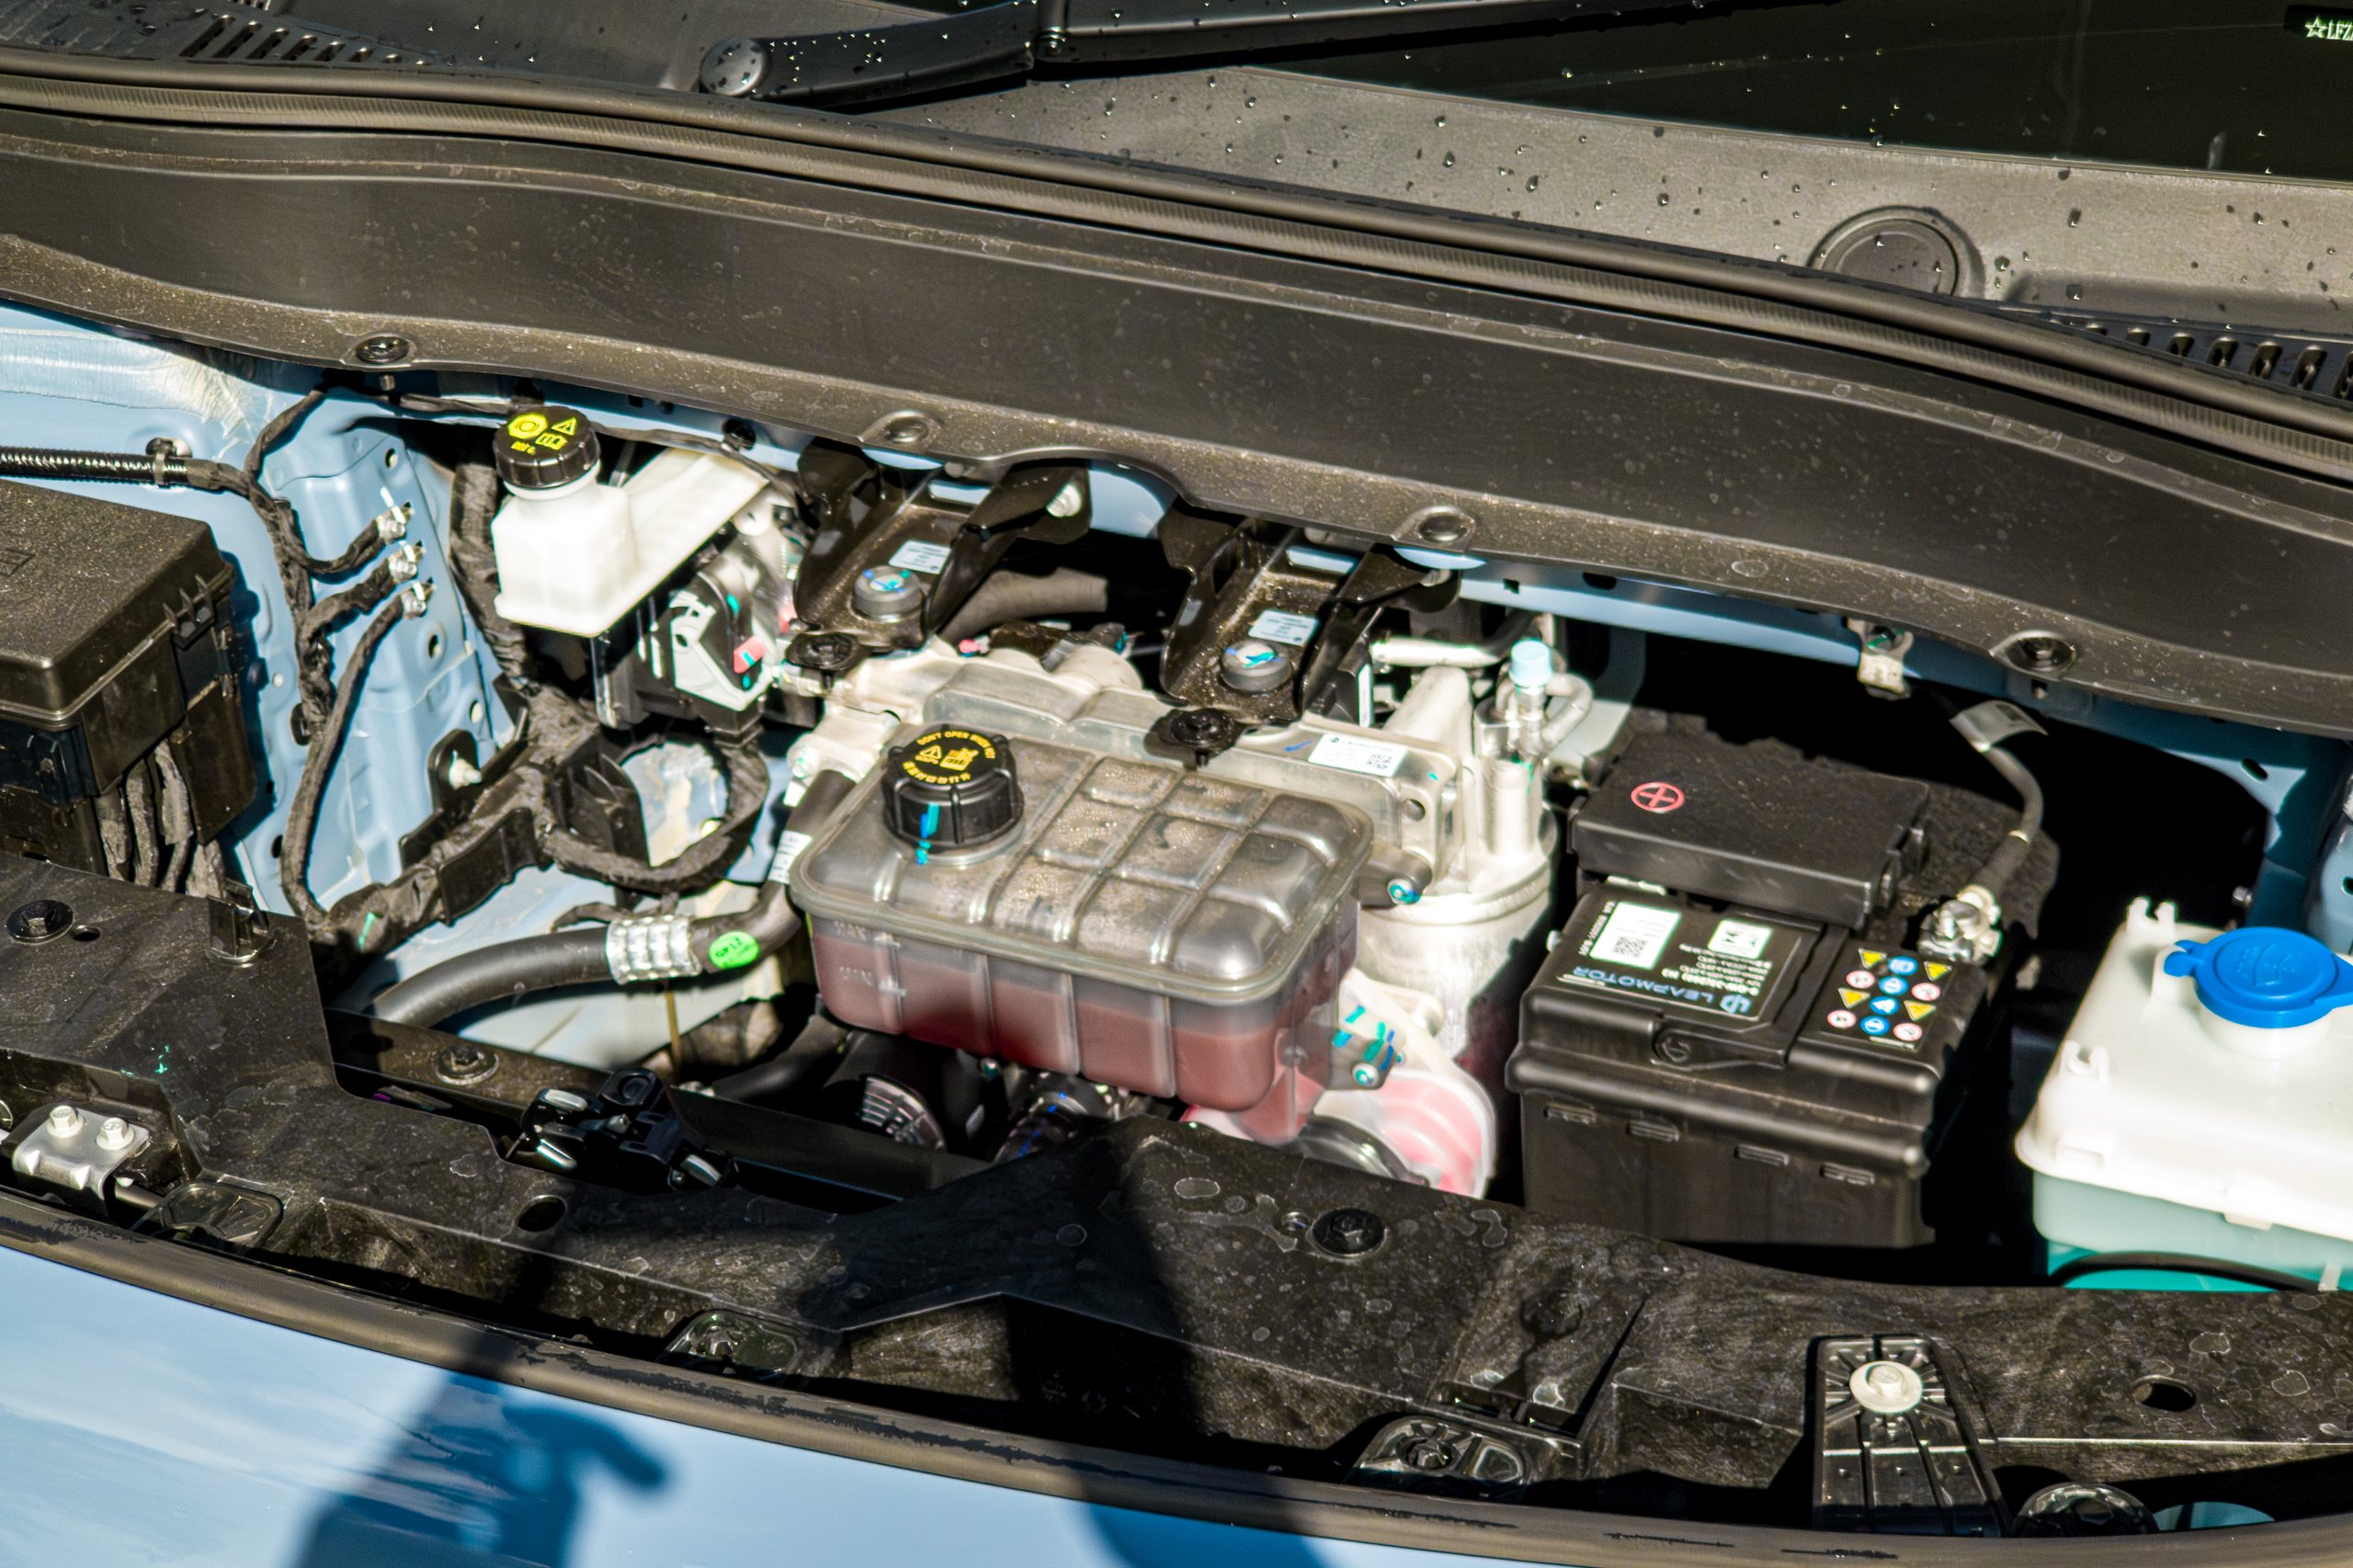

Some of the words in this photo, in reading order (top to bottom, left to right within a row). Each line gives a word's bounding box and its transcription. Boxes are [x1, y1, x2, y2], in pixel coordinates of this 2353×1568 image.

[2326, 19, 2353, 41] LFZ
[944, 731, 971, 739] OPEN
[1572, 966, 1715, 1005] LEAPMOTOR
